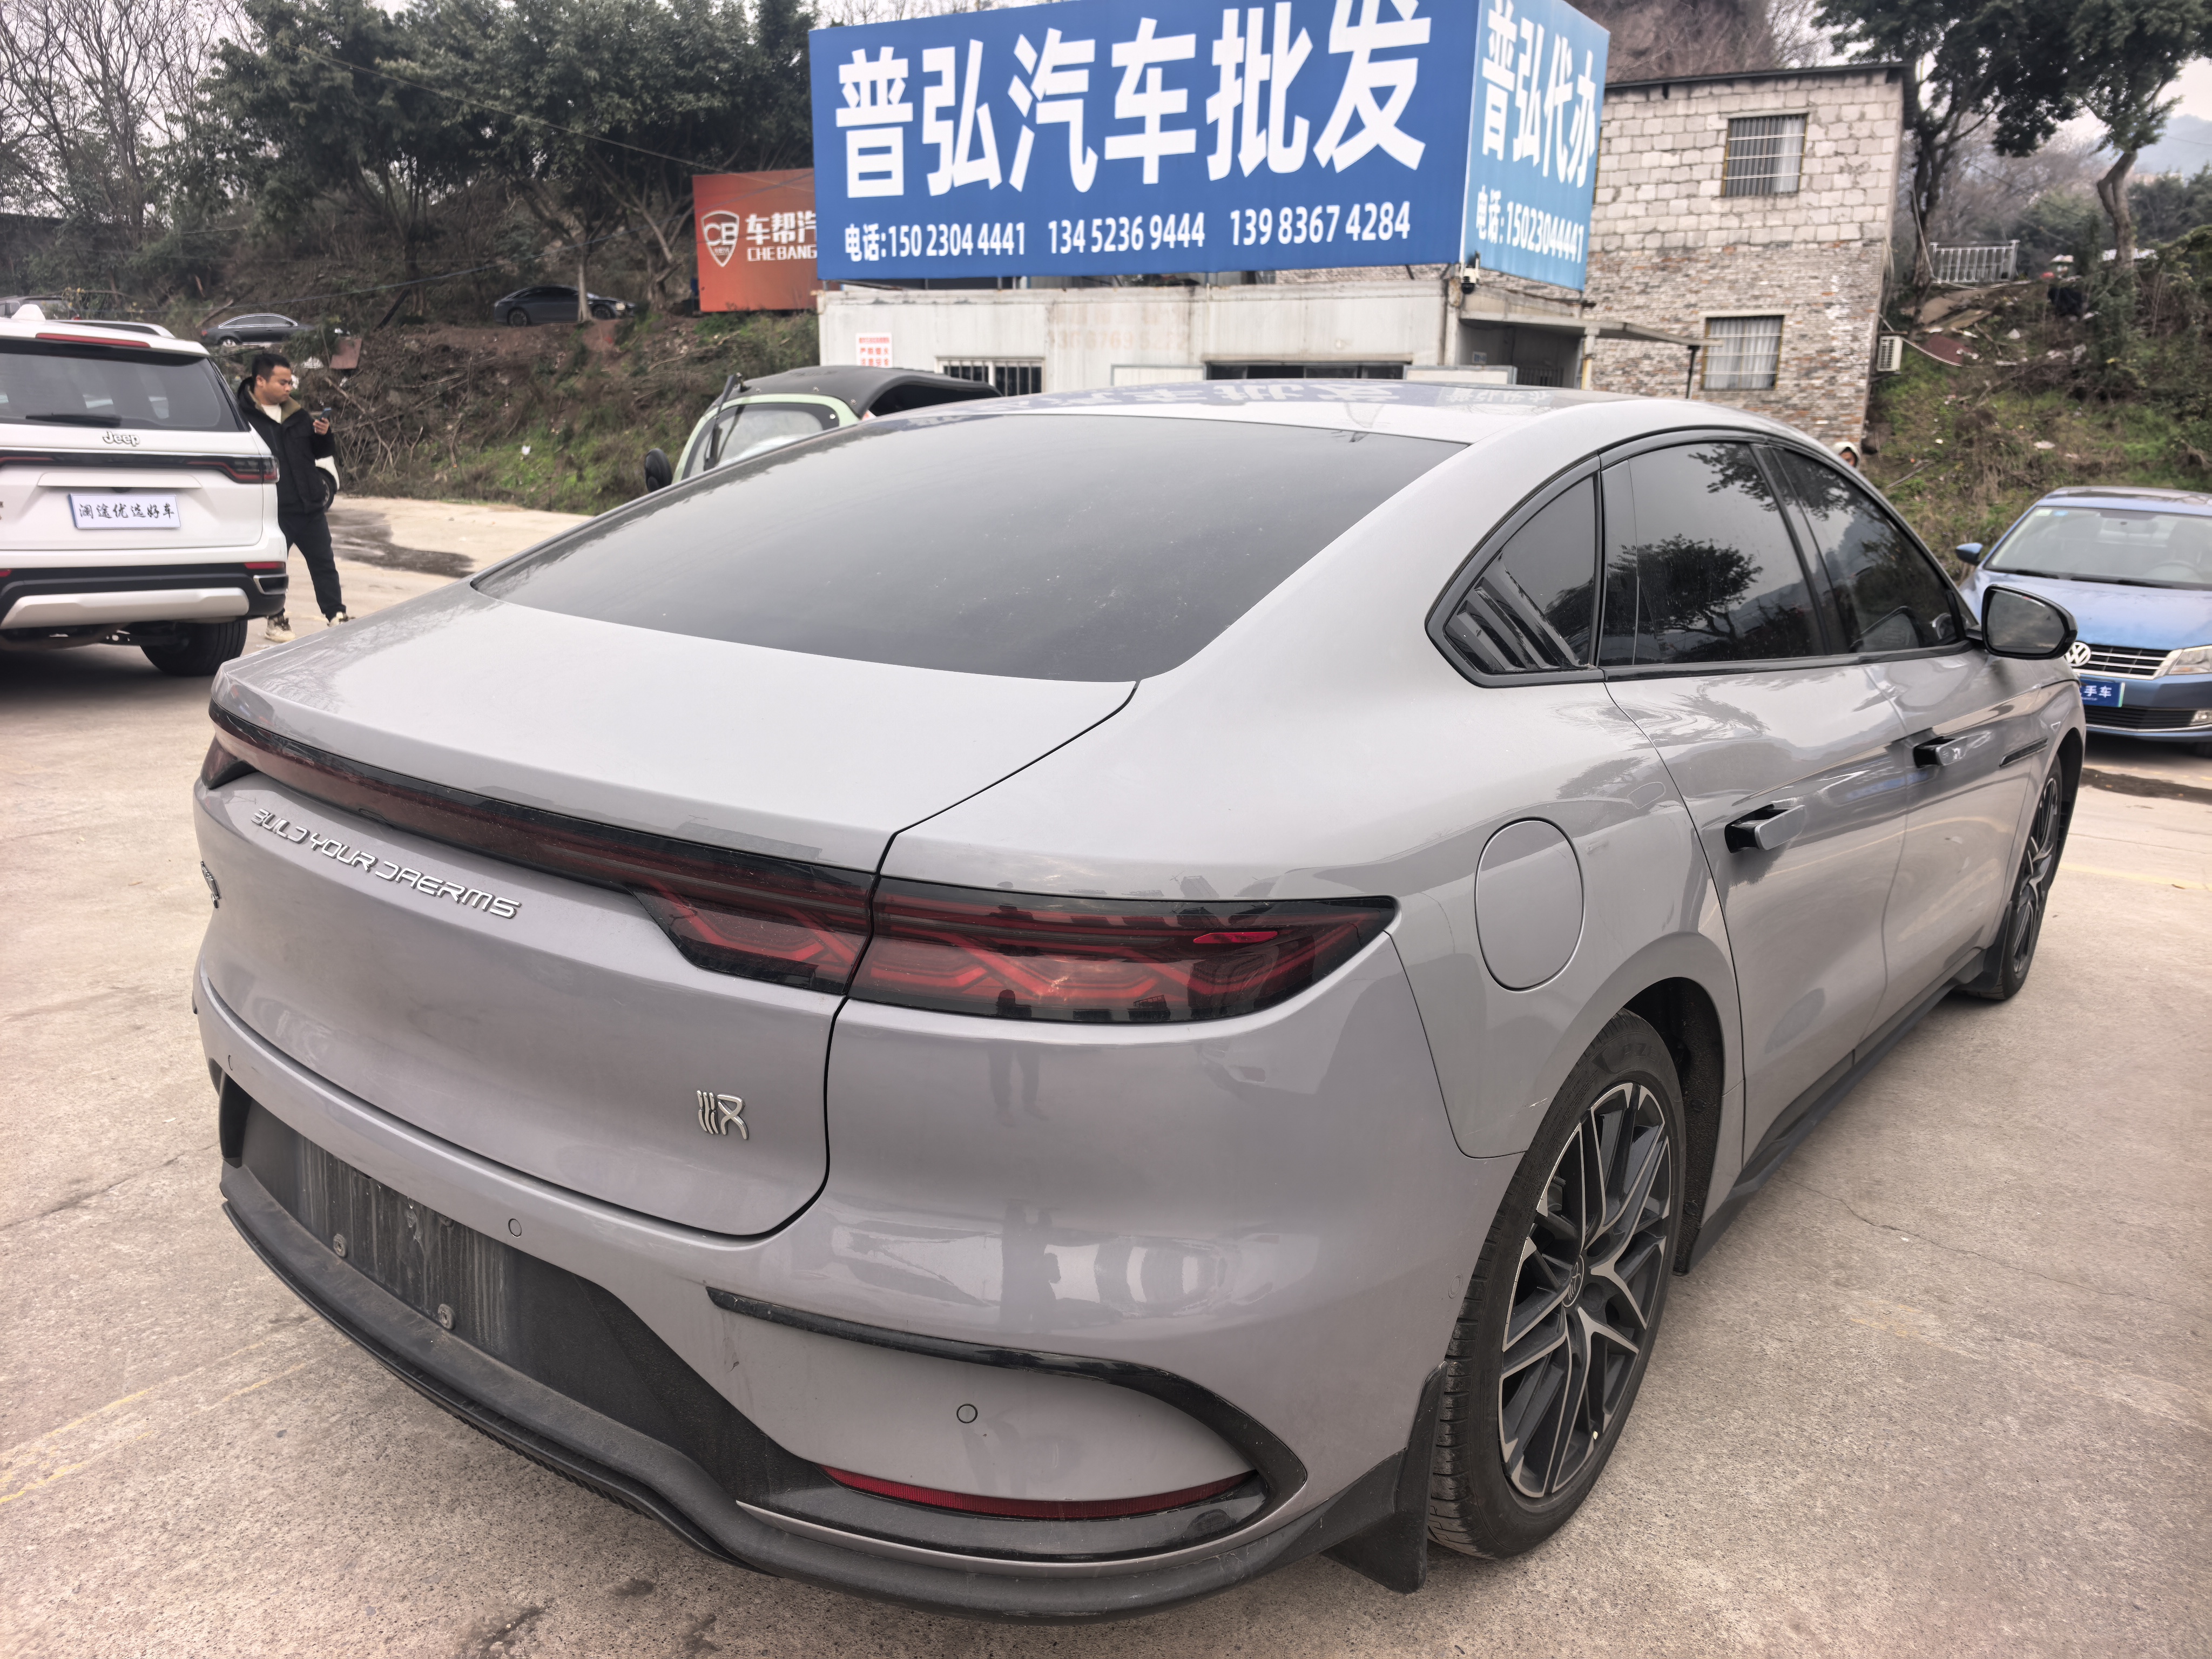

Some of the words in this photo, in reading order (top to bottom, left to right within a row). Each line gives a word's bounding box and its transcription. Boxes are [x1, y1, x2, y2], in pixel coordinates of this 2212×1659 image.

[837, 0, 1431, 198] 普弘汽车批发
[1482, 0, 1596, 188] 普弘代办
[926, 223, 974, 257] 2304
[977, 222, 1024, 256] 4441
[1049, 219, 1085, 254] 134
[1091, 215, 1144, 253] 5236
[1150, 212, 1205, 250] 9444
[1230, 207, 1273, 246] 139
[1278, 204, 1340, 245] 8367
[1345, 200, 1411, 241] 4284
[102, 430, 140, 447] Jeep
[2080, 685, 2112, 698] 手车
[310, 832, 378, 873] YOUR
